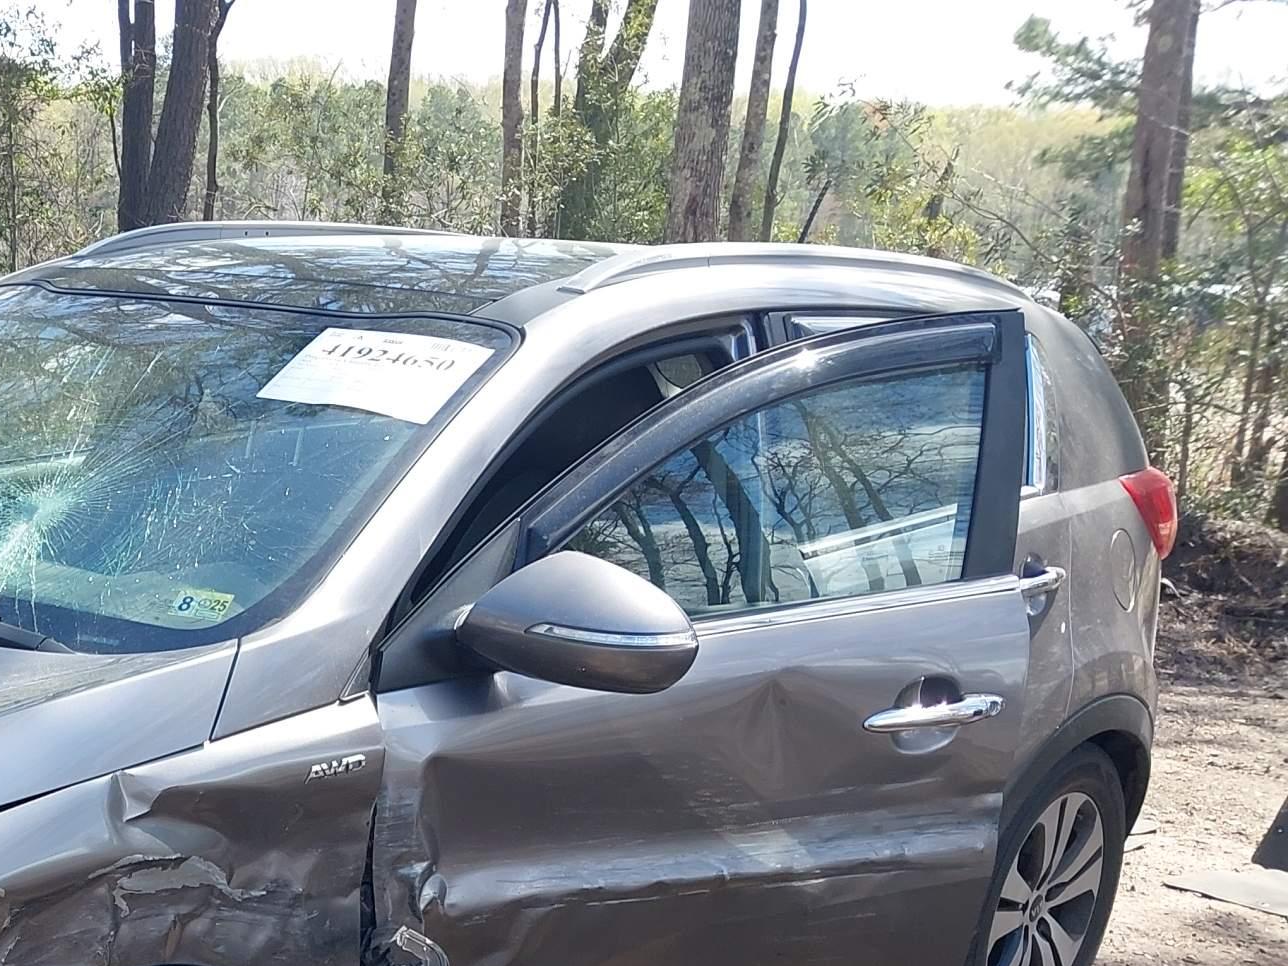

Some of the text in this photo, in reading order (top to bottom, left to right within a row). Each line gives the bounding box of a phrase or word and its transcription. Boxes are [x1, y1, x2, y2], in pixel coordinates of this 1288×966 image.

[322, 343, 455, 371] 41924650
[178, 596, 229, 612] 8 25
[304, 753, 366, 785] AWD
